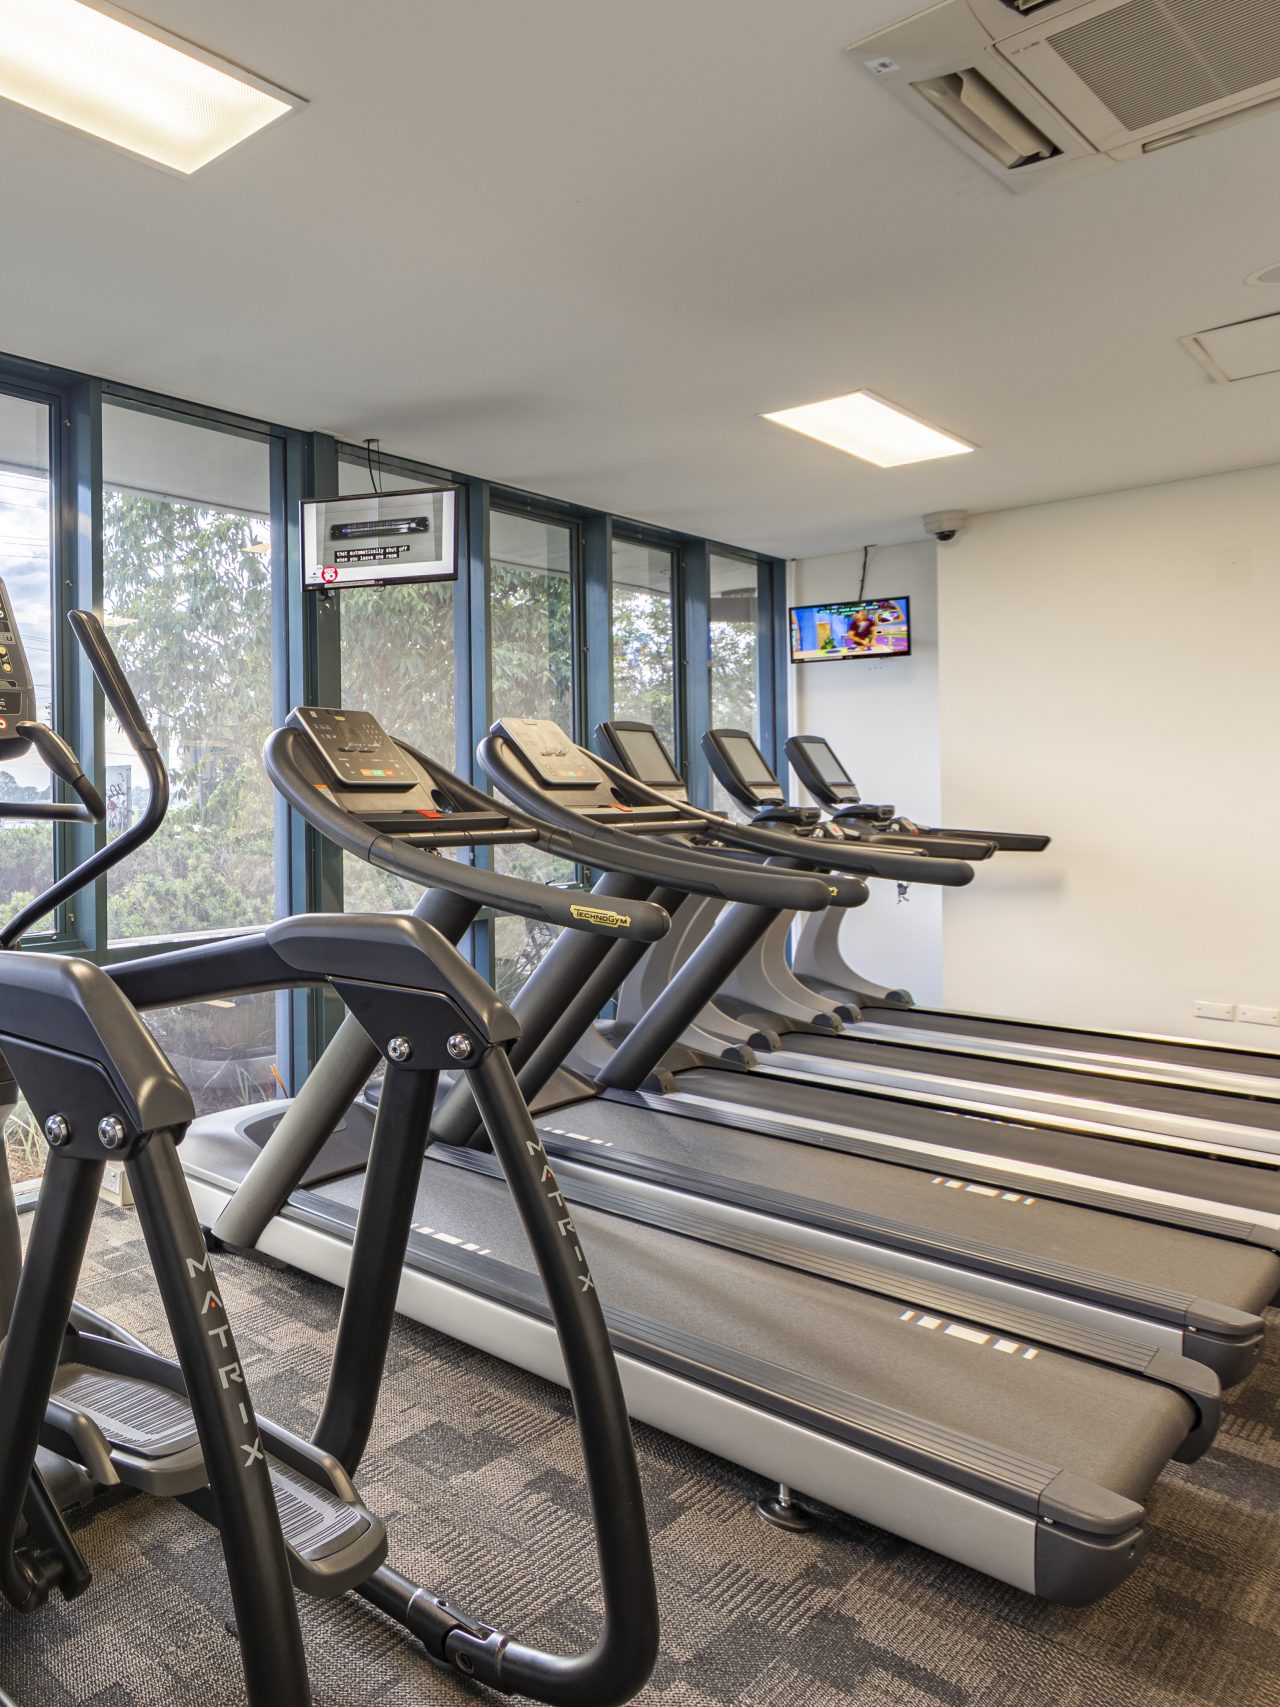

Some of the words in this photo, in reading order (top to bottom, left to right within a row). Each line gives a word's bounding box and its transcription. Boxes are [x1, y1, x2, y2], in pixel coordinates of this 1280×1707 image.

[349, 548, 384, 556] automatically
[525, 1139, 595, 1293] MATRIX
[185, 1252, 265, 1468] MATRIX
